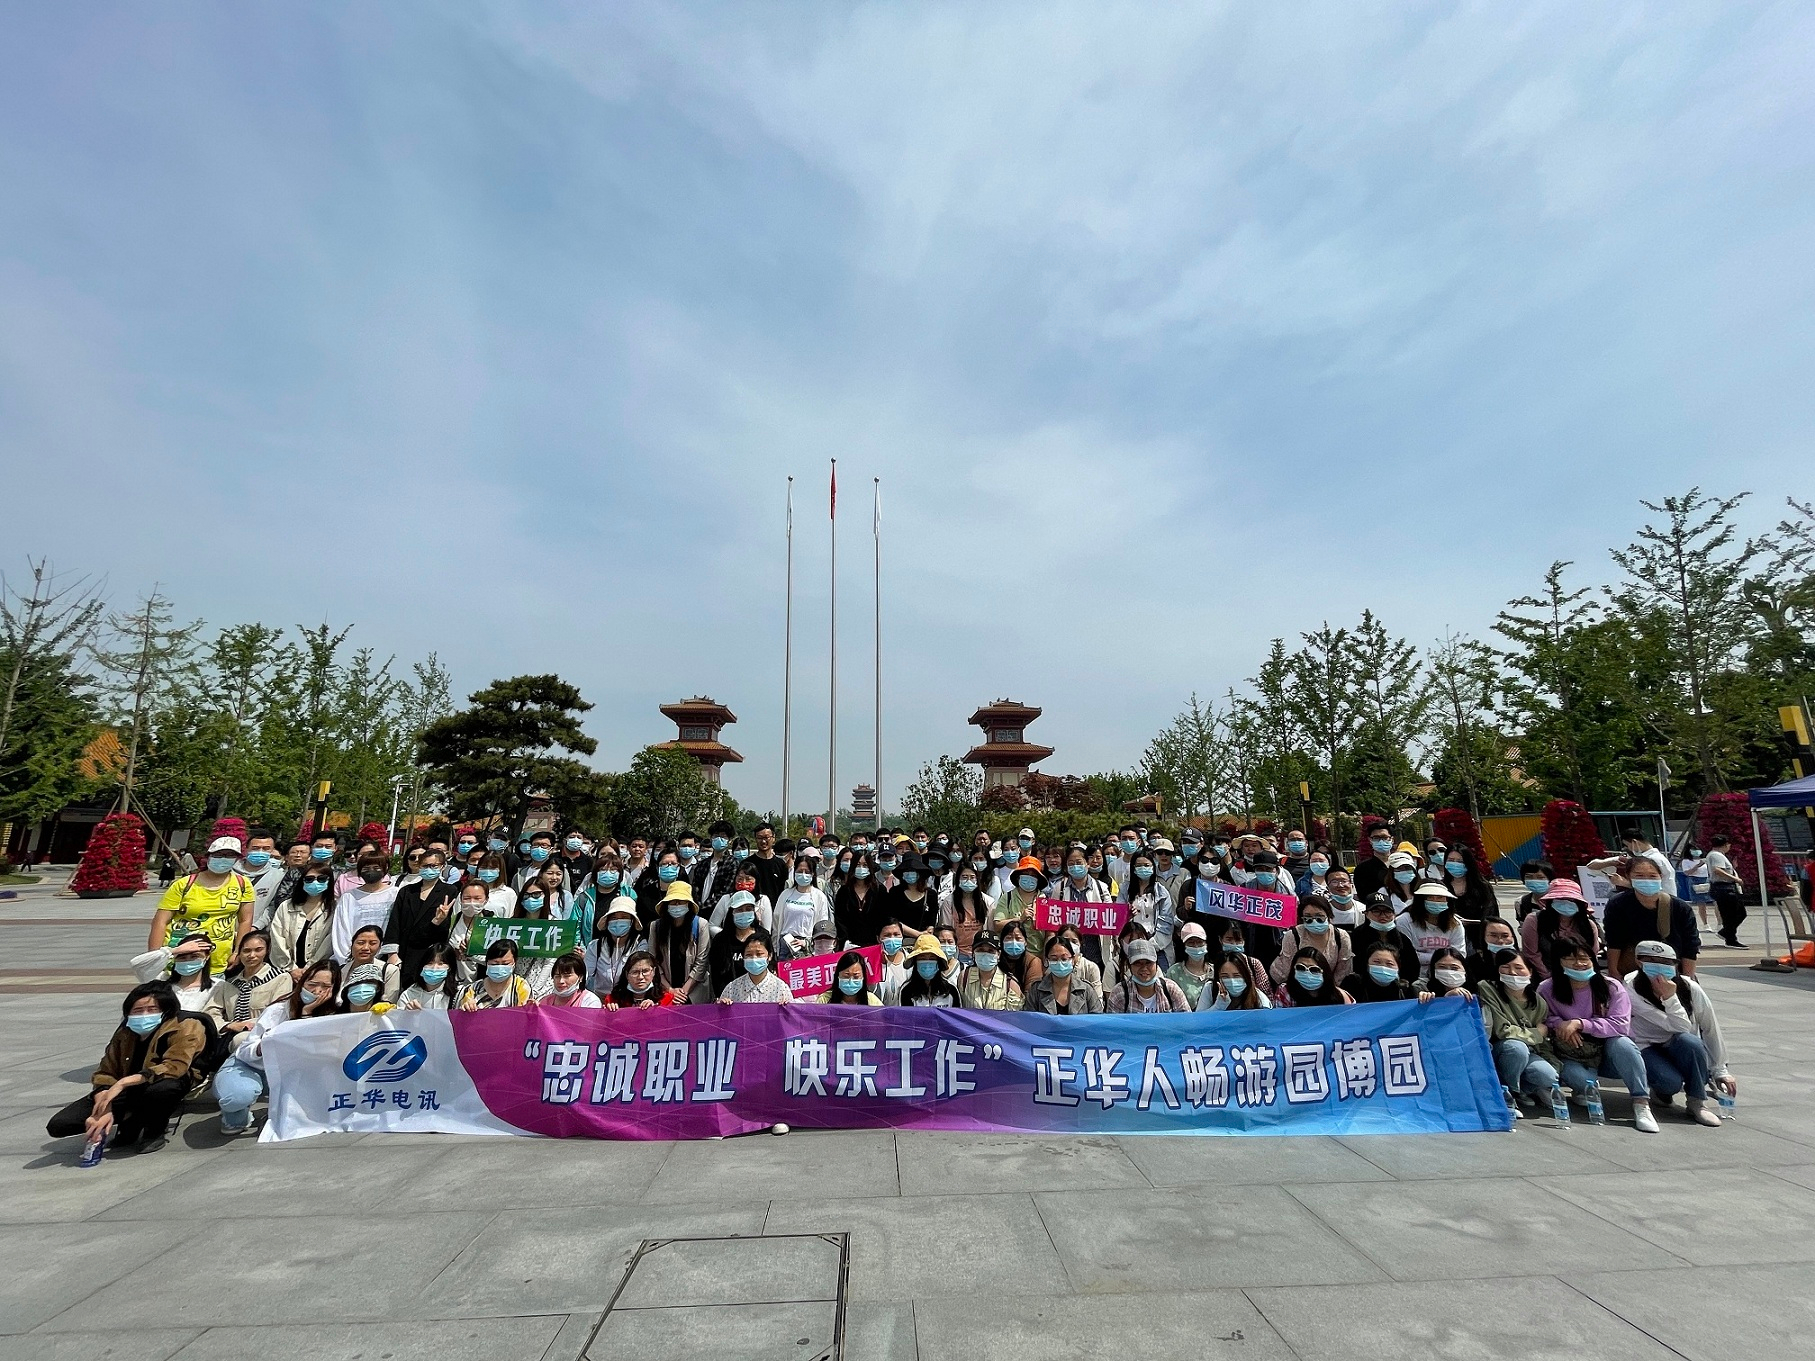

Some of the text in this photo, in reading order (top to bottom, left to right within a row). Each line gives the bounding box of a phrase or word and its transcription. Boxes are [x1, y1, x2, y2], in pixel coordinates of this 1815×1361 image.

[1048, 904, 1117, 930] 忠诚职业
[1209, 888, 1284, 920] 风华正茂
[981, 931, 990, 939] NY
[523, 1035, 1429, 1109] “忠诚职业 快乐工作” 正华人畅游园博园
[327, 1088, 441, 1112] 正华电讯
